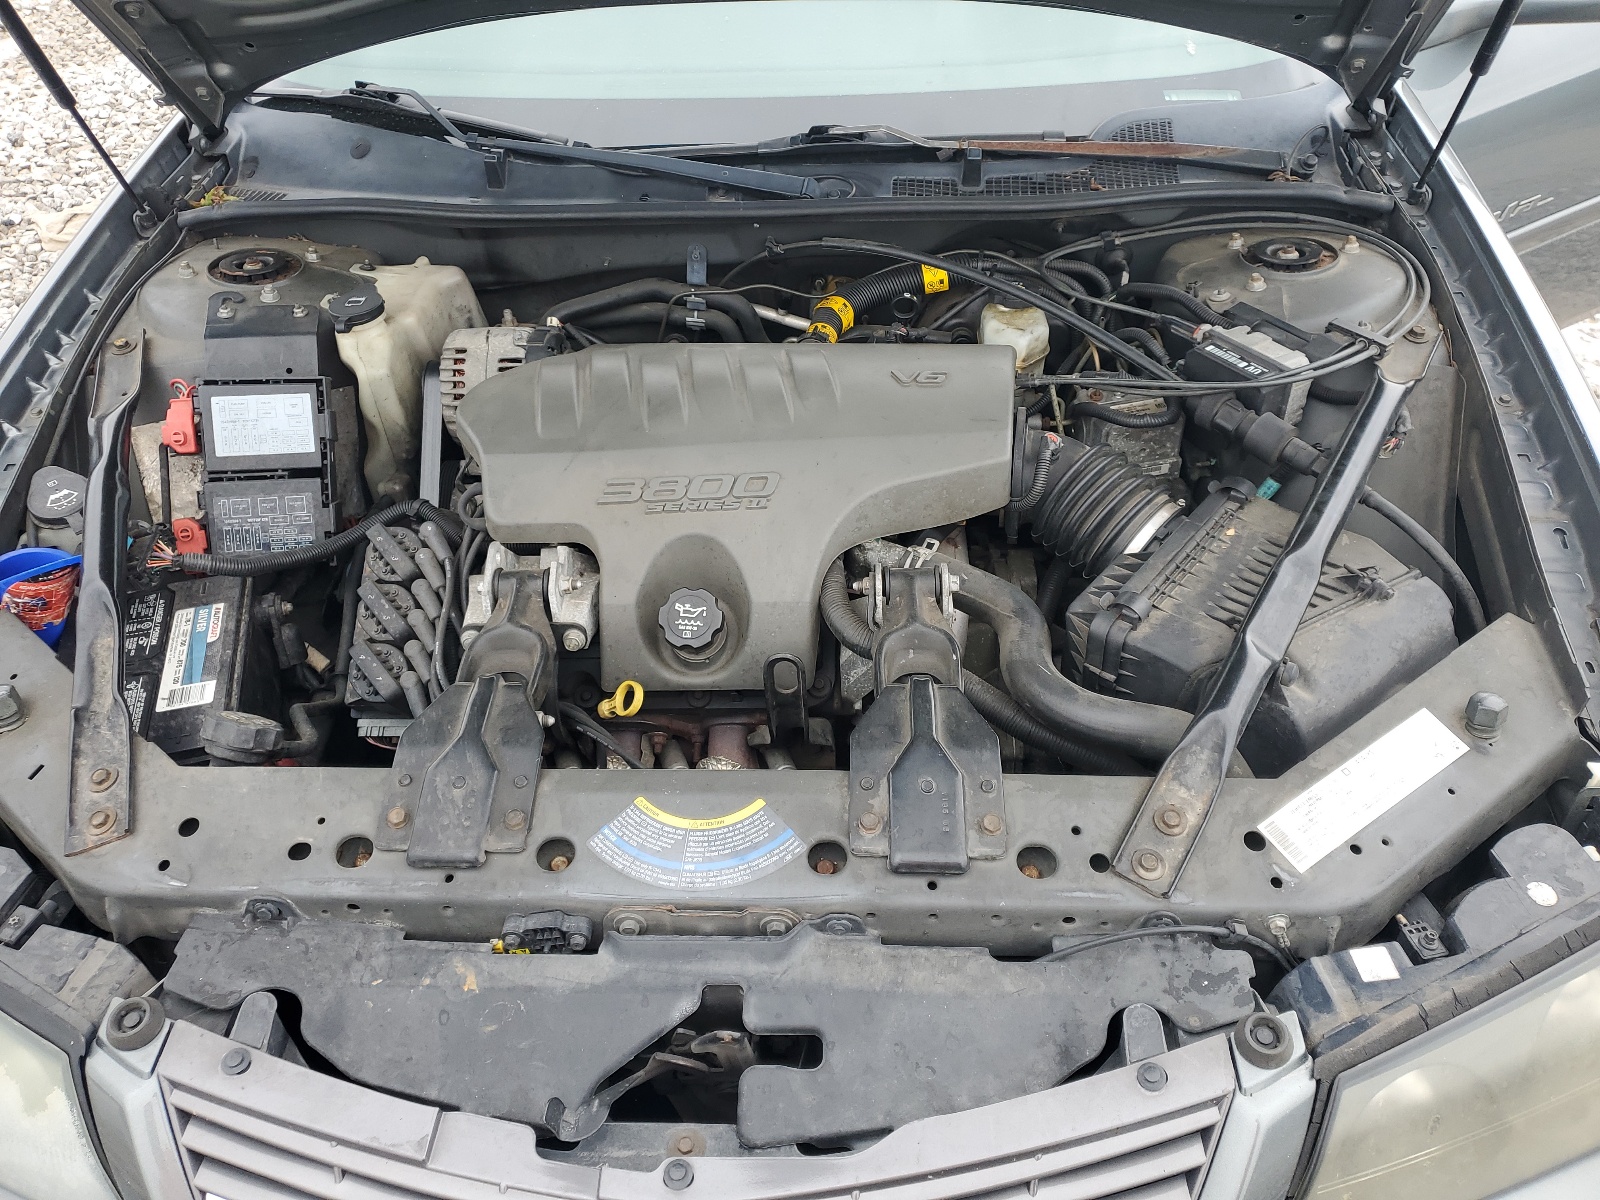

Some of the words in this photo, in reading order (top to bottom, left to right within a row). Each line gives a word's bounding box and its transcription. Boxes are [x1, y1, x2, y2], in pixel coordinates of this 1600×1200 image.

[890, 370, 948, 387] V6
[597, 472, 781, 505] 3800
[645, 500, 742, 515] SERIES
[196, 608, 209, 633] SILVER
